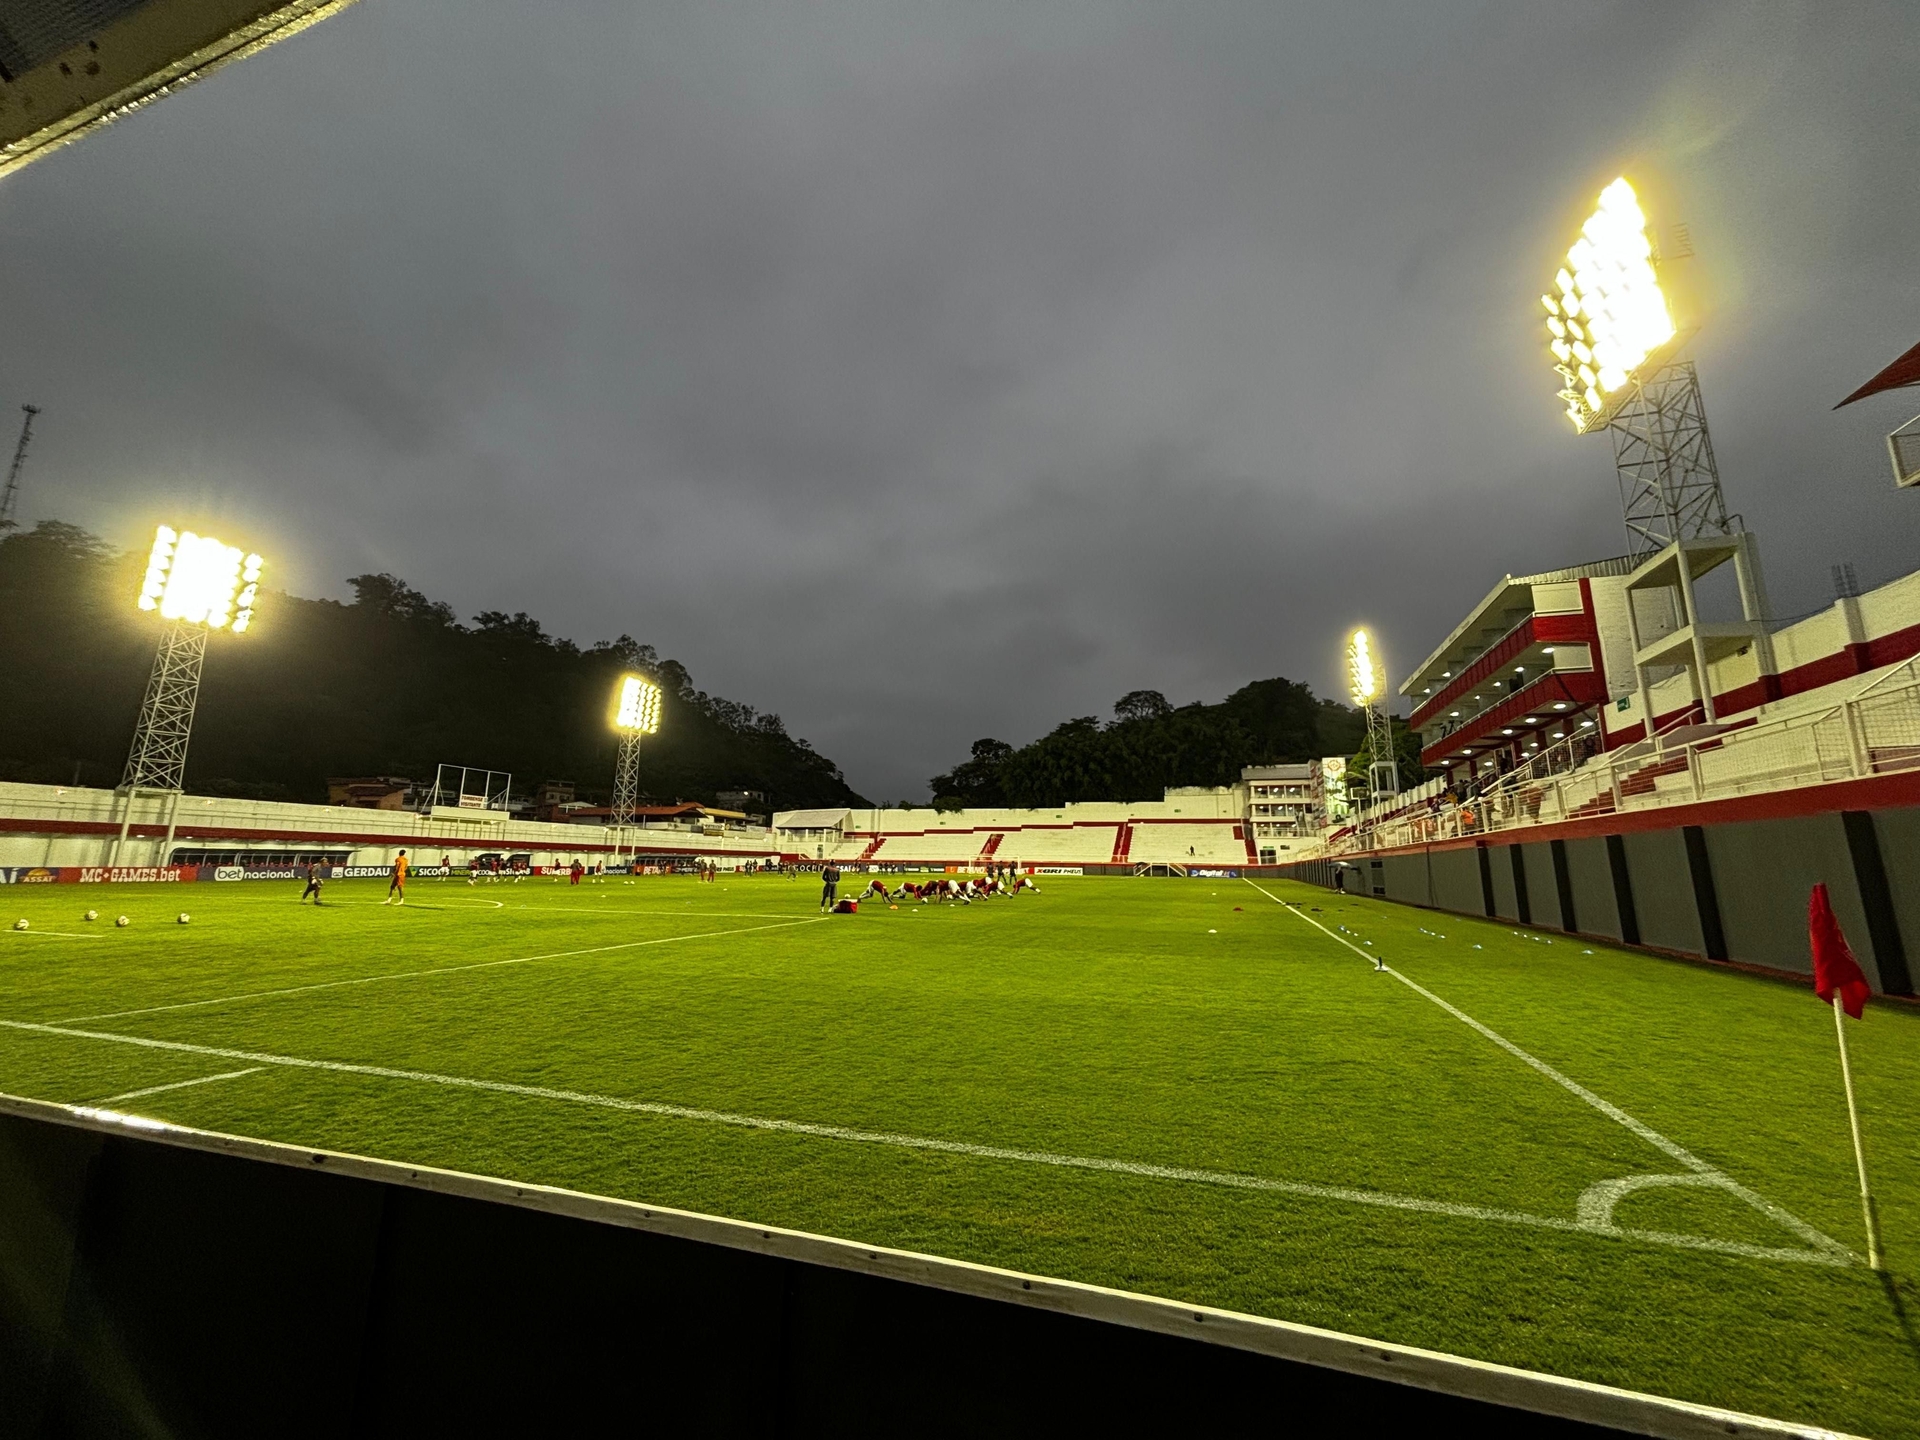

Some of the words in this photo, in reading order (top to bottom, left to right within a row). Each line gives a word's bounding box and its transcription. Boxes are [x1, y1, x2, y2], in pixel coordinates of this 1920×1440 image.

[217, 868, 243, 880] bet
[244, 869, 295, 879] nacional
[344, 867, 390, 877] GERDAU
